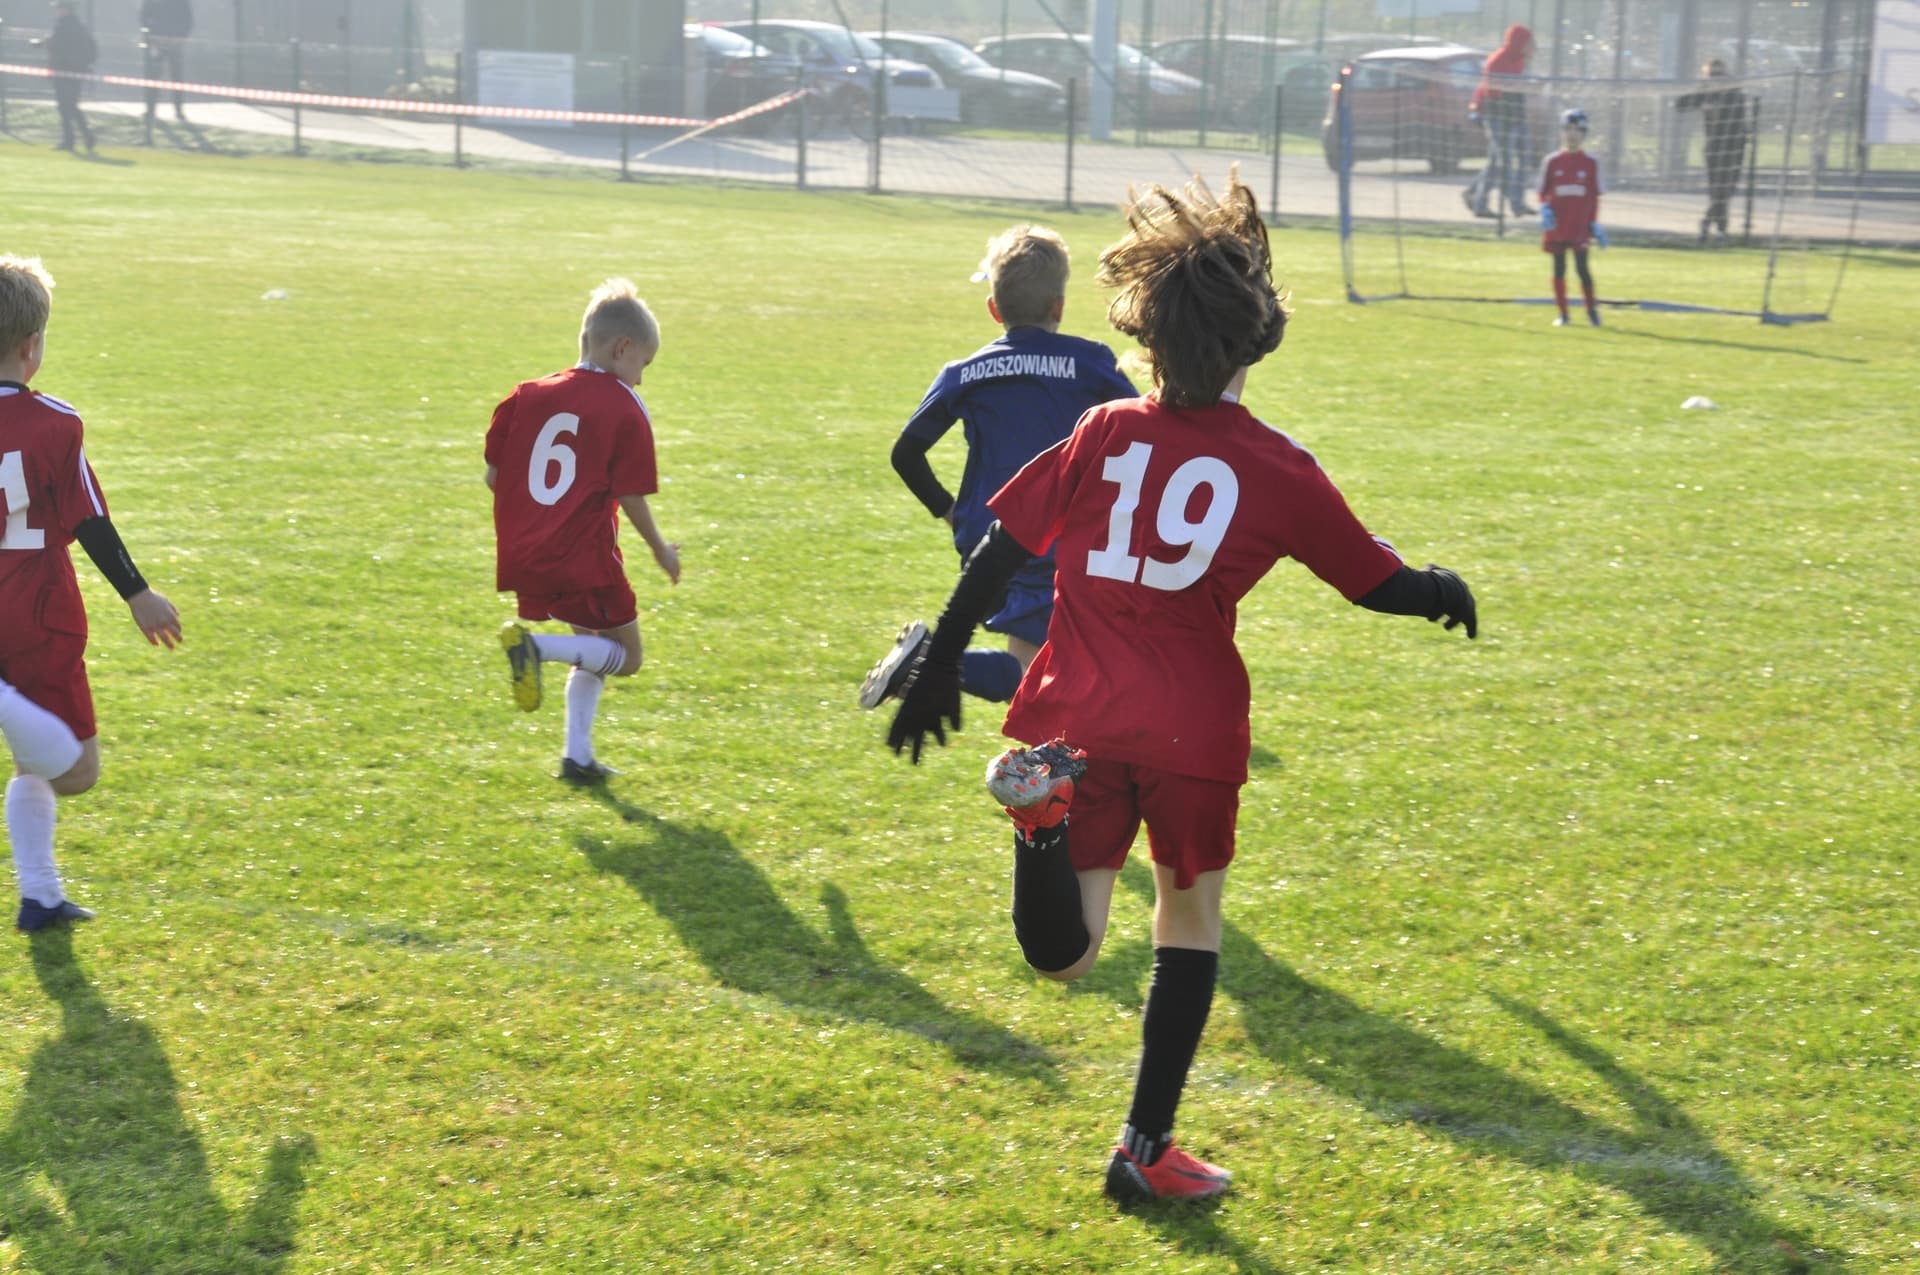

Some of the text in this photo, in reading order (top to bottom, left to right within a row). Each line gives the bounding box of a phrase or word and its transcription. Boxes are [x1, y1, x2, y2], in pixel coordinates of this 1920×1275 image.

[960, 354, 1076, 384] RADZISZOWIANKA
[528, 412, 580, 506] 6
[1086, 441, 1239, 591] 19
